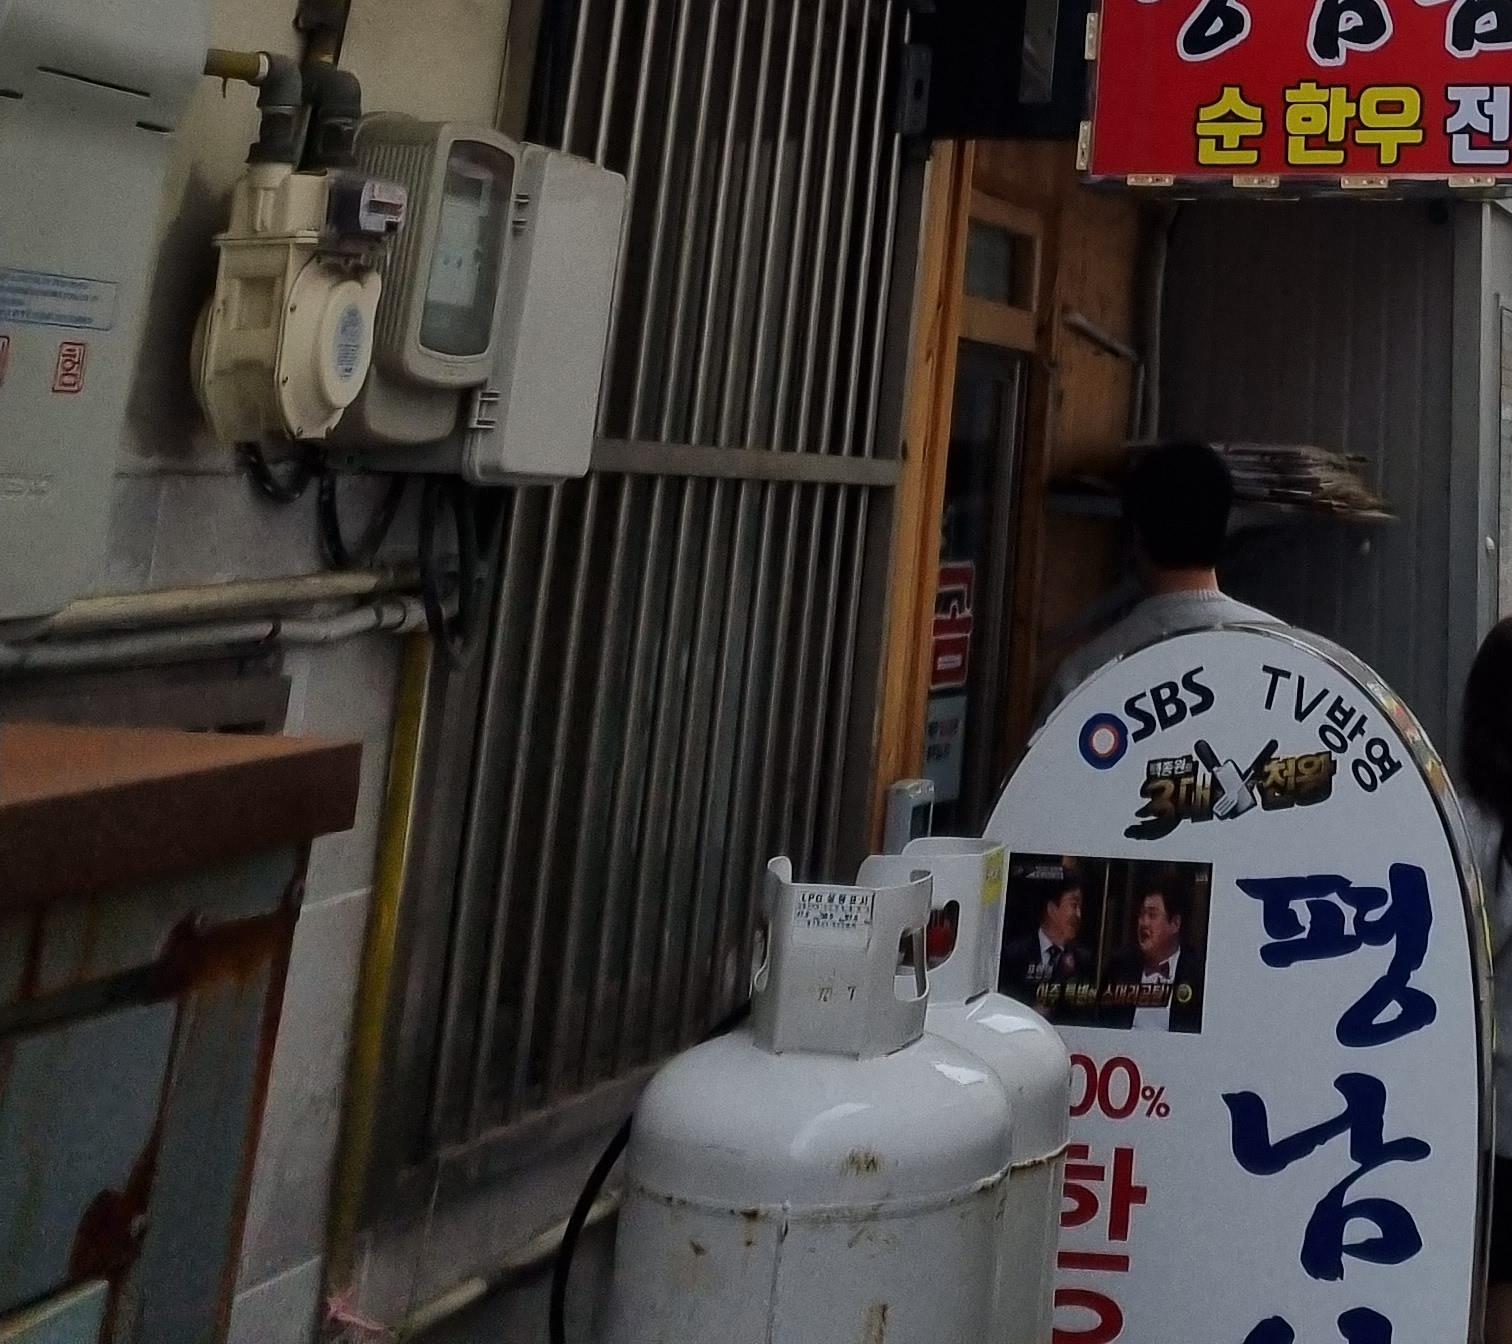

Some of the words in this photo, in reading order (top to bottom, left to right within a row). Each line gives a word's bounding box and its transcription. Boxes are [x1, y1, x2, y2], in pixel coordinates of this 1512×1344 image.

[1195, 85, 1264, 167] 순
[1284, 81, 1425, 166] 한우
[1123, 665, 1215, 744] SBS
